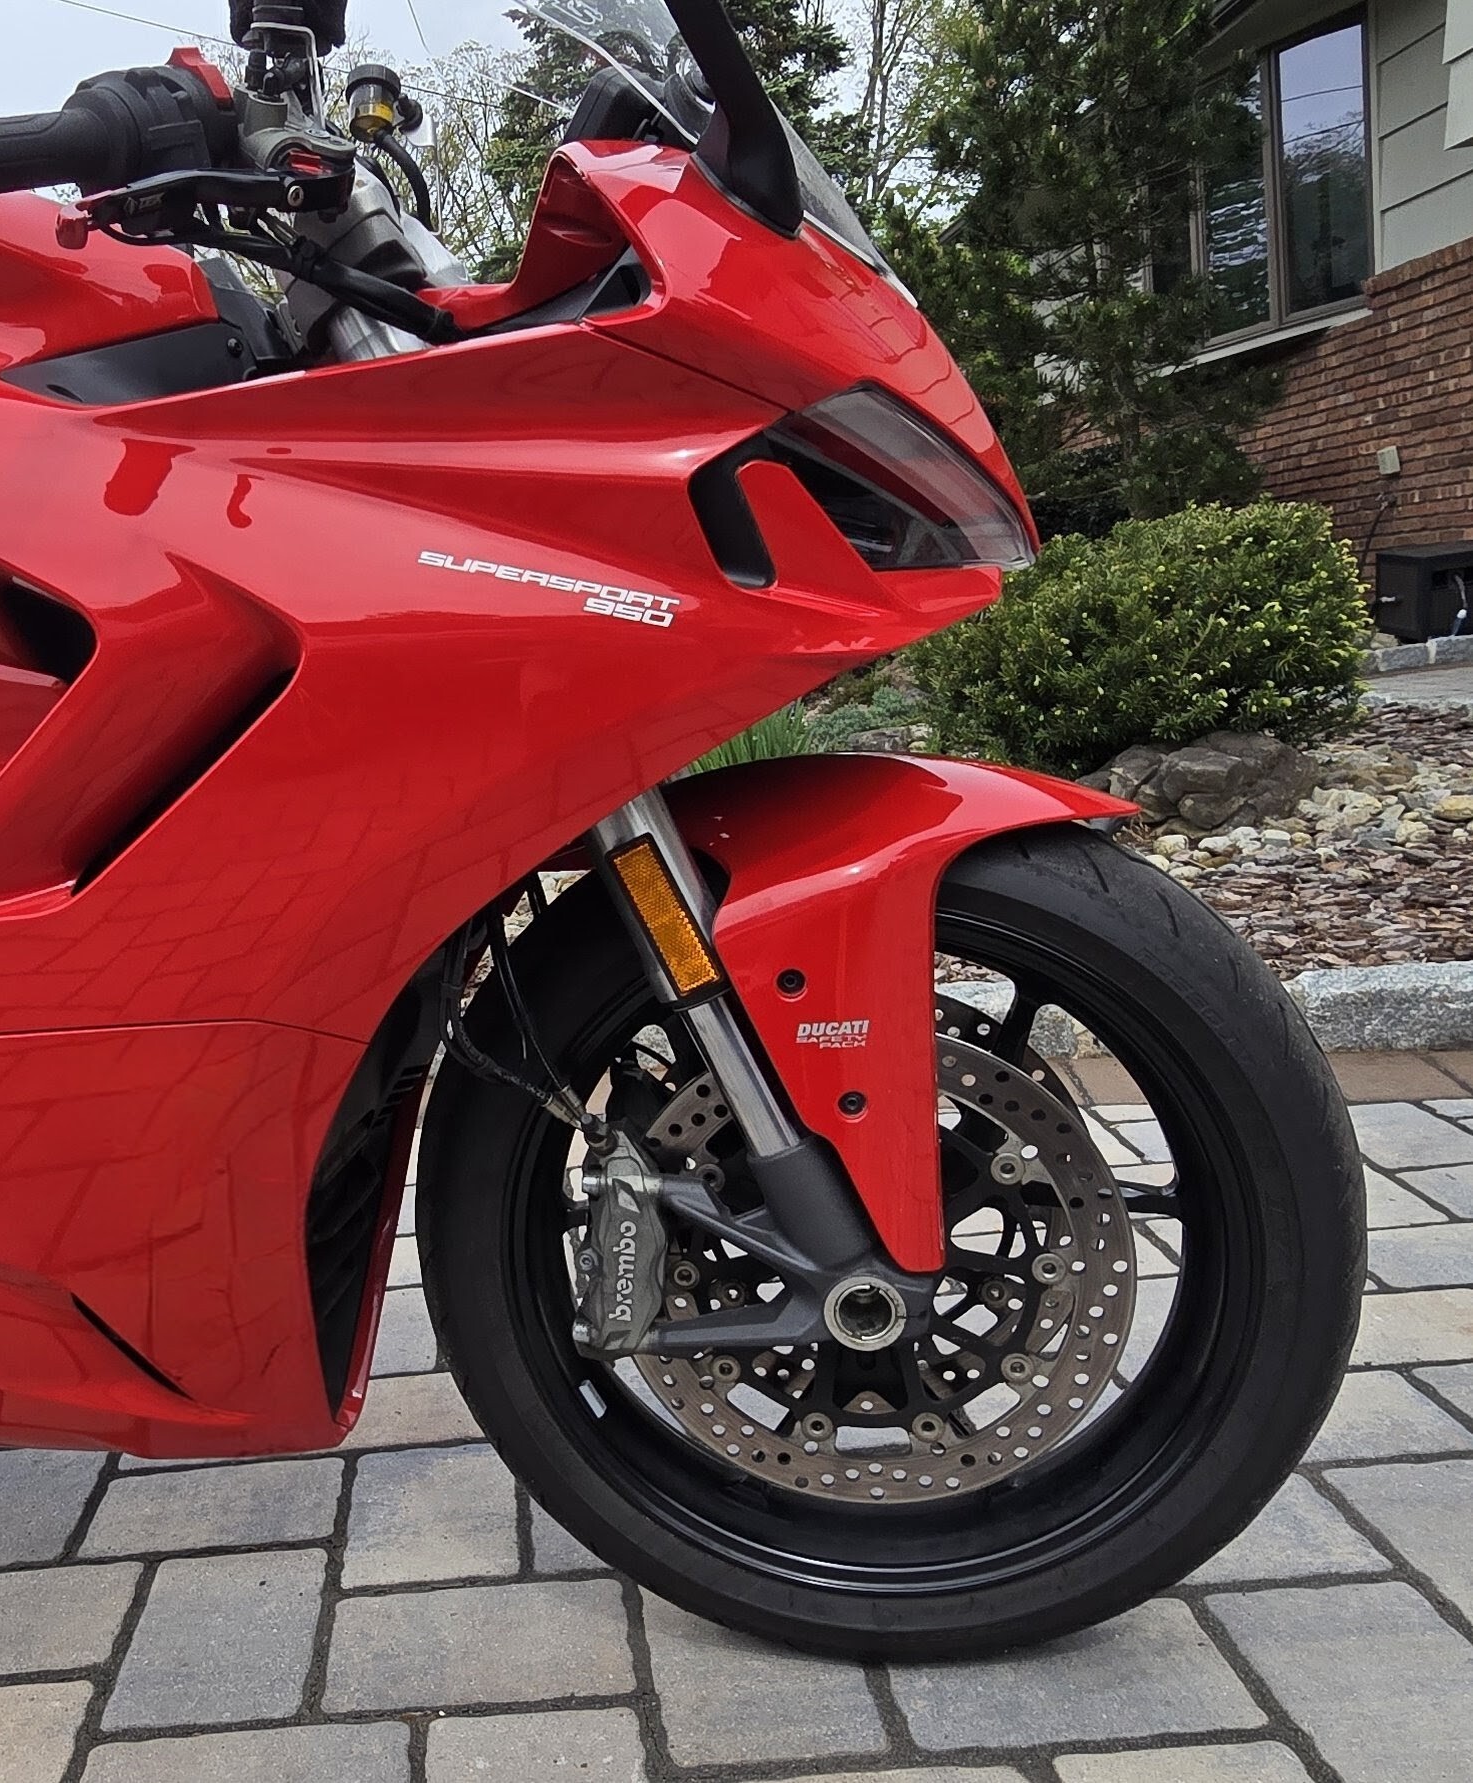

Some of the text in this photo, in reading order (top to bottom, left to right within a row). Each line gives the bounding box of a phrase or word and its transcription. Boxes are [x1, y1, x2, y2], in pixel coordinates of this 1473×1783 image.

[418, 551, 680, 610] SUPERSPORT
[583, 598, 674, 627] 950
[796, 1034, 866, 1043] SAFETY
[797, 1020, 869, 1036] DUCATI
[819, 1041, 866, 1049] PACK
[609, 1221, 637, 1322] brembo
